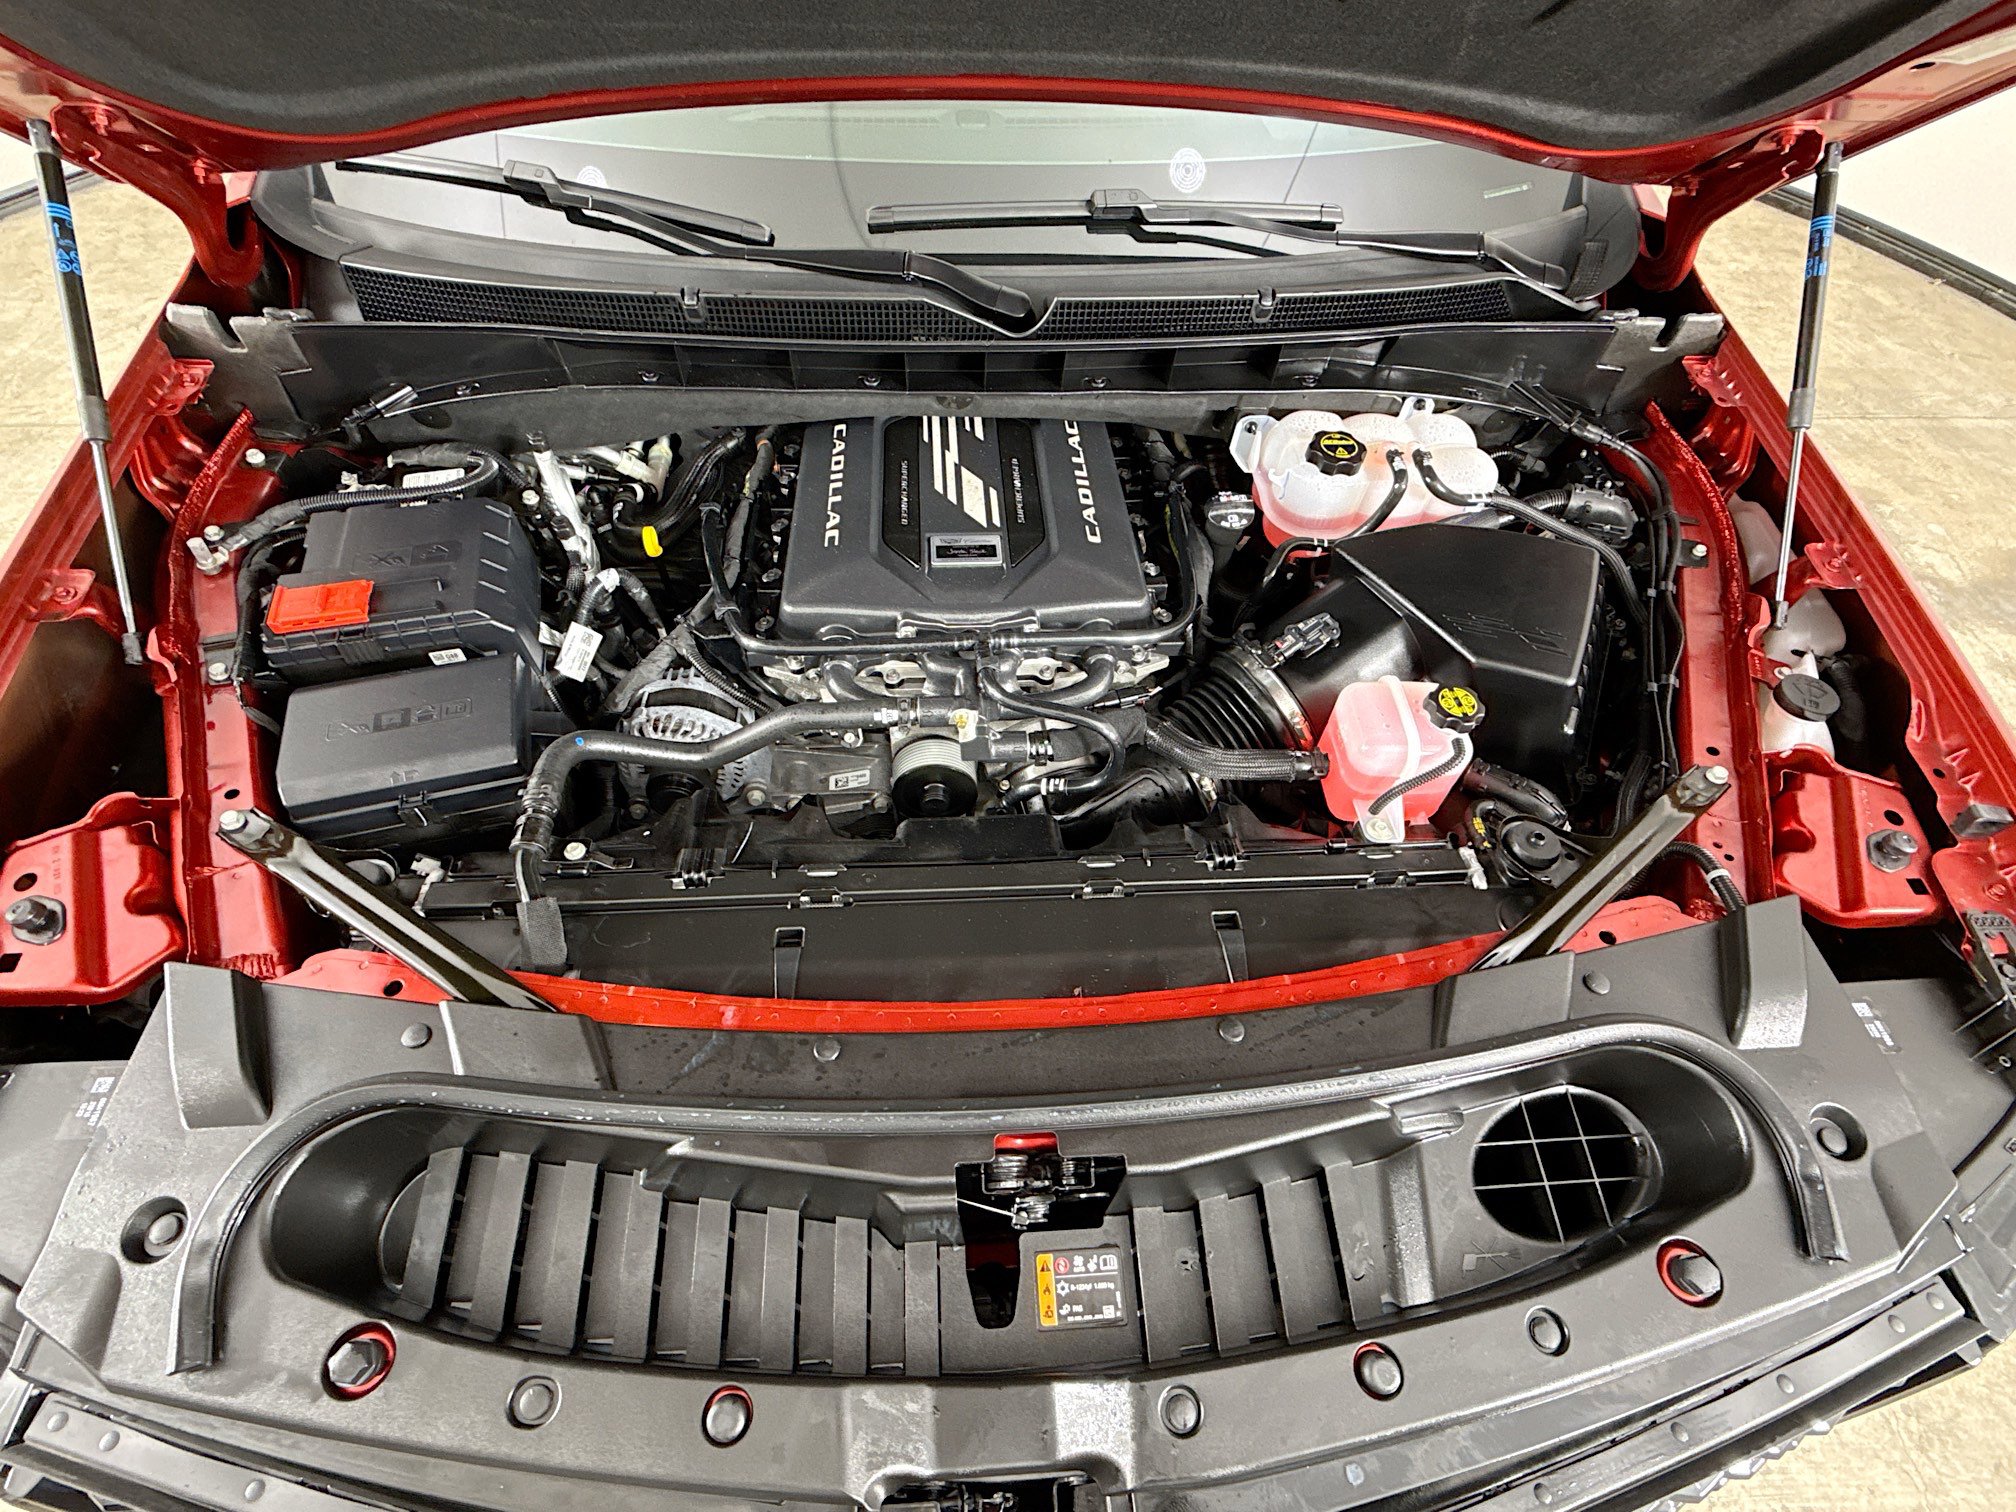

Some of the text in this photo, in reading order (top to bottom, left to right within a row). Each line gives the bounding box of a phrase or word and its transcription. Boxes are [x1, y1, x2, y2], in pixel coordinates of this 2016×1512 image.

[824, 423, 846, 547] CADILLAC
[900, 460, 908, 525] SUPERCHARGED
[1011, 458, 1025, 524] SUPERCHARGED
[1064, 420, 1102, 543] CADILLAC
